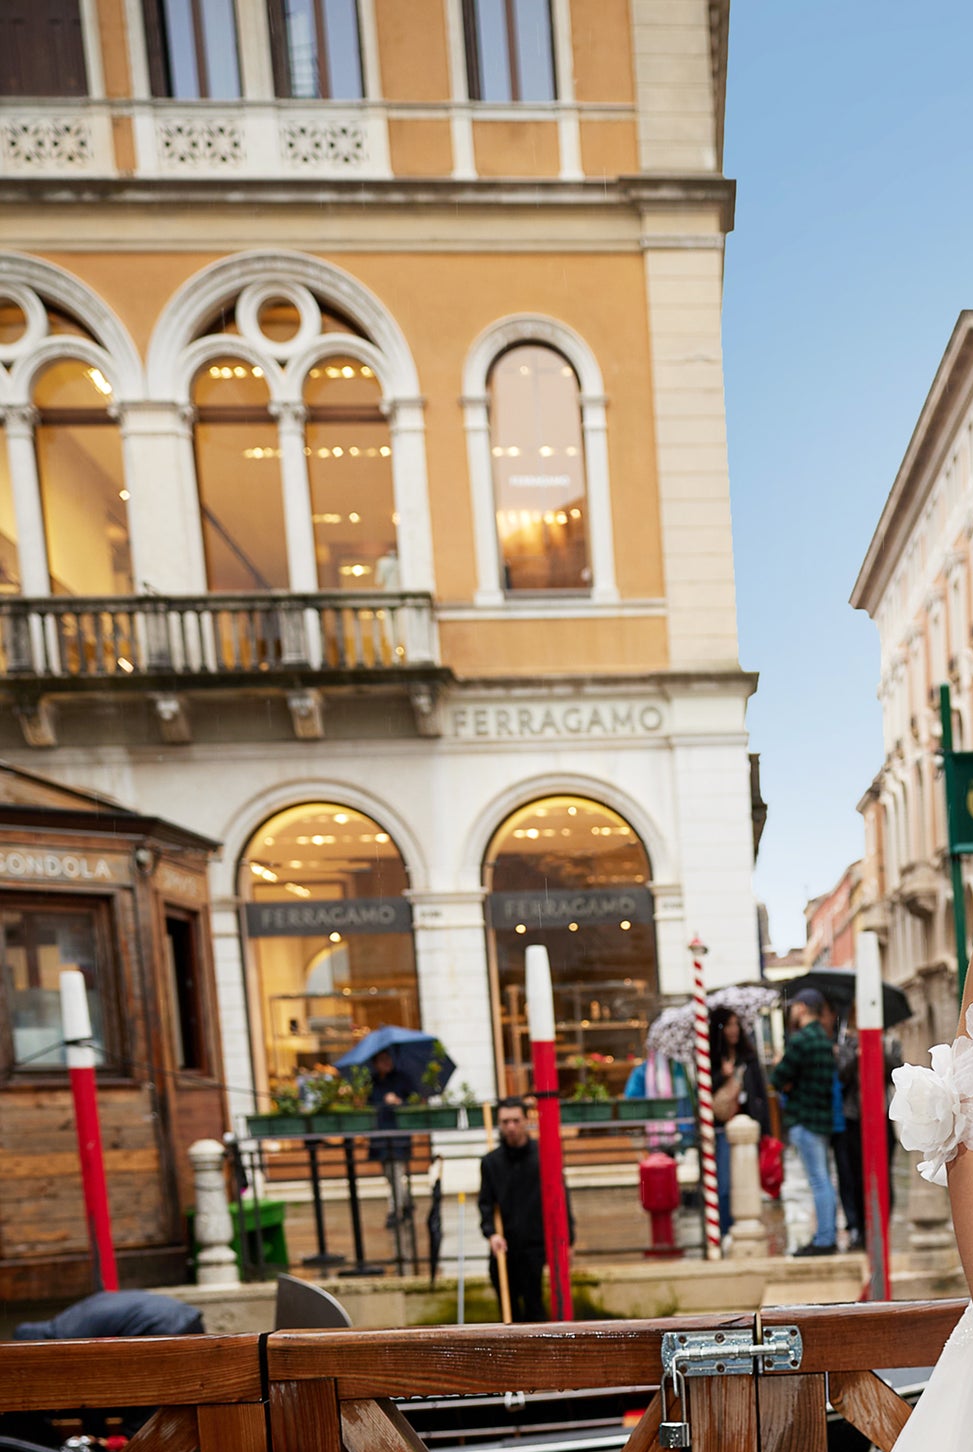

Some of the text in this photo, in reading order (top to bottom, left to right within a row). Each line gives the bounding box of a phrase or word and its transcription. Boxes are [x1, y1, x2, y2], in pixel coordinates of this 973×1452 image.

[453, 706, 663, 737] FERRAGAMO
[0, 852, 112, 879] ONDOLA
[261, 905, 396, 928] FERRAGAMO
[506, 896, 636, 920] FERRAGAMO
